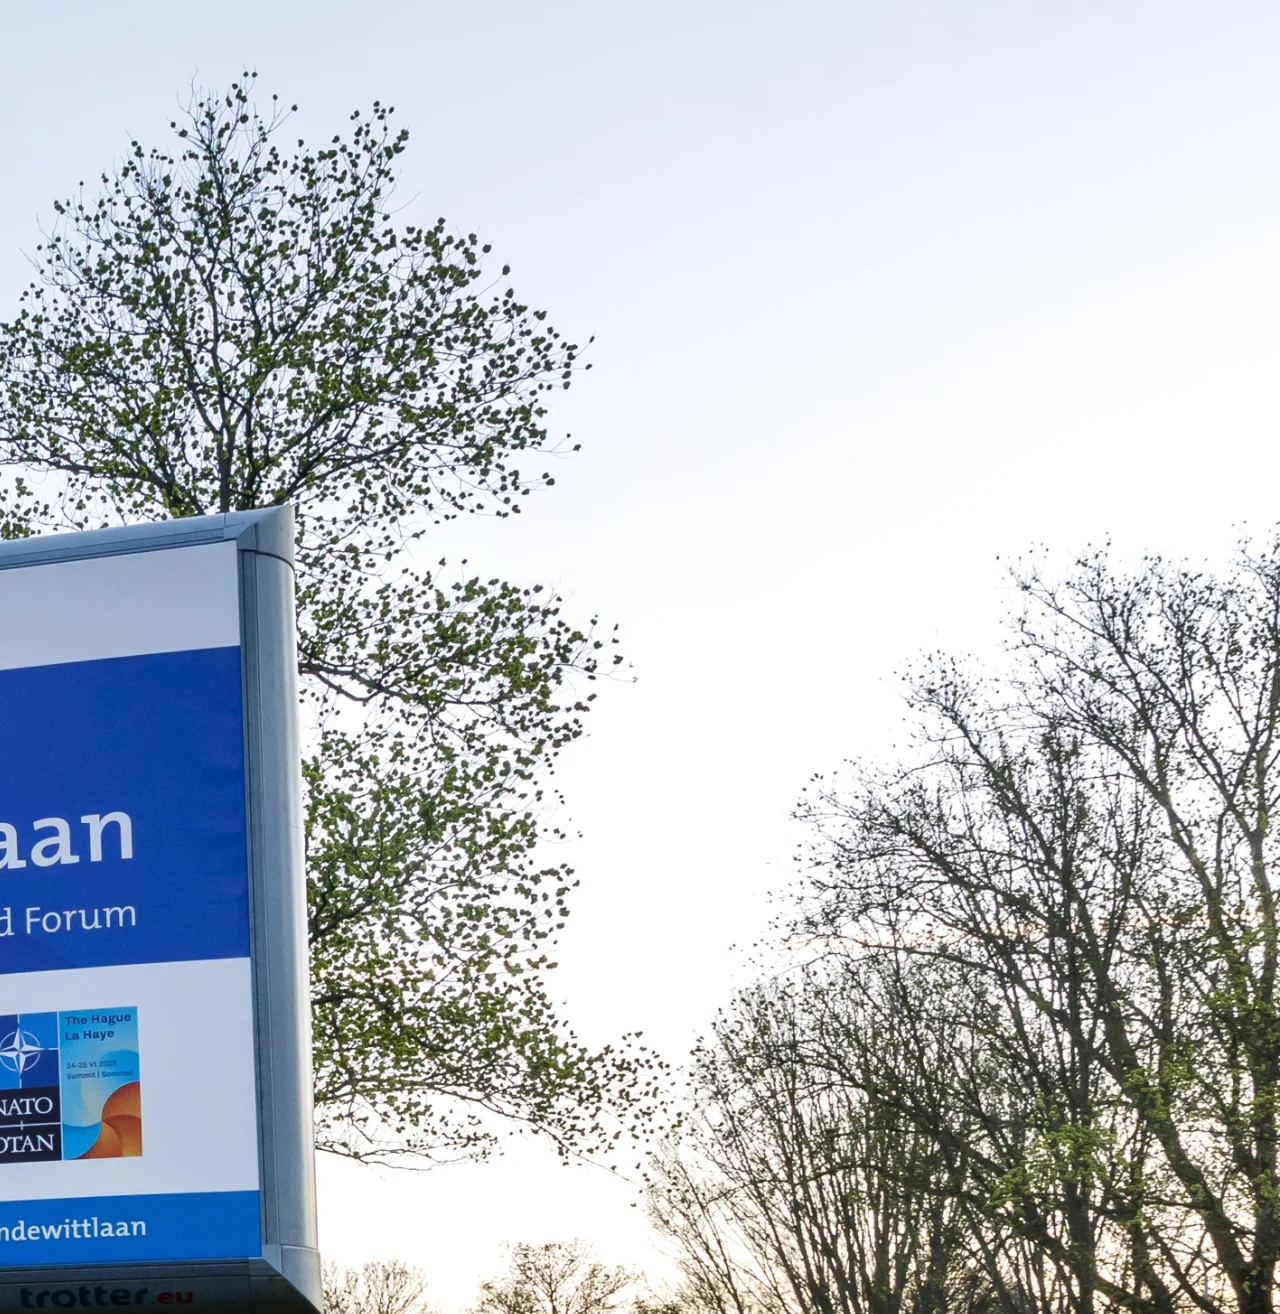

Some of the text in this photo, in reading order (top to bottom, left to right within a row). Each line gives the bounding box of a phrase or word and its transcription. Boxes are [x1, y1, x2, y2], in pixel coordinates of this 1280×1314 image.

[25, 905, 137, 935] Forum
[65, 1013, 132, 1026] The Hague
[65, 1030, 115, 1042] La Haye
[66, 1069, 133, 1080] Summit Sommet
[20, 1285, 194, 1308] trotter.eu
